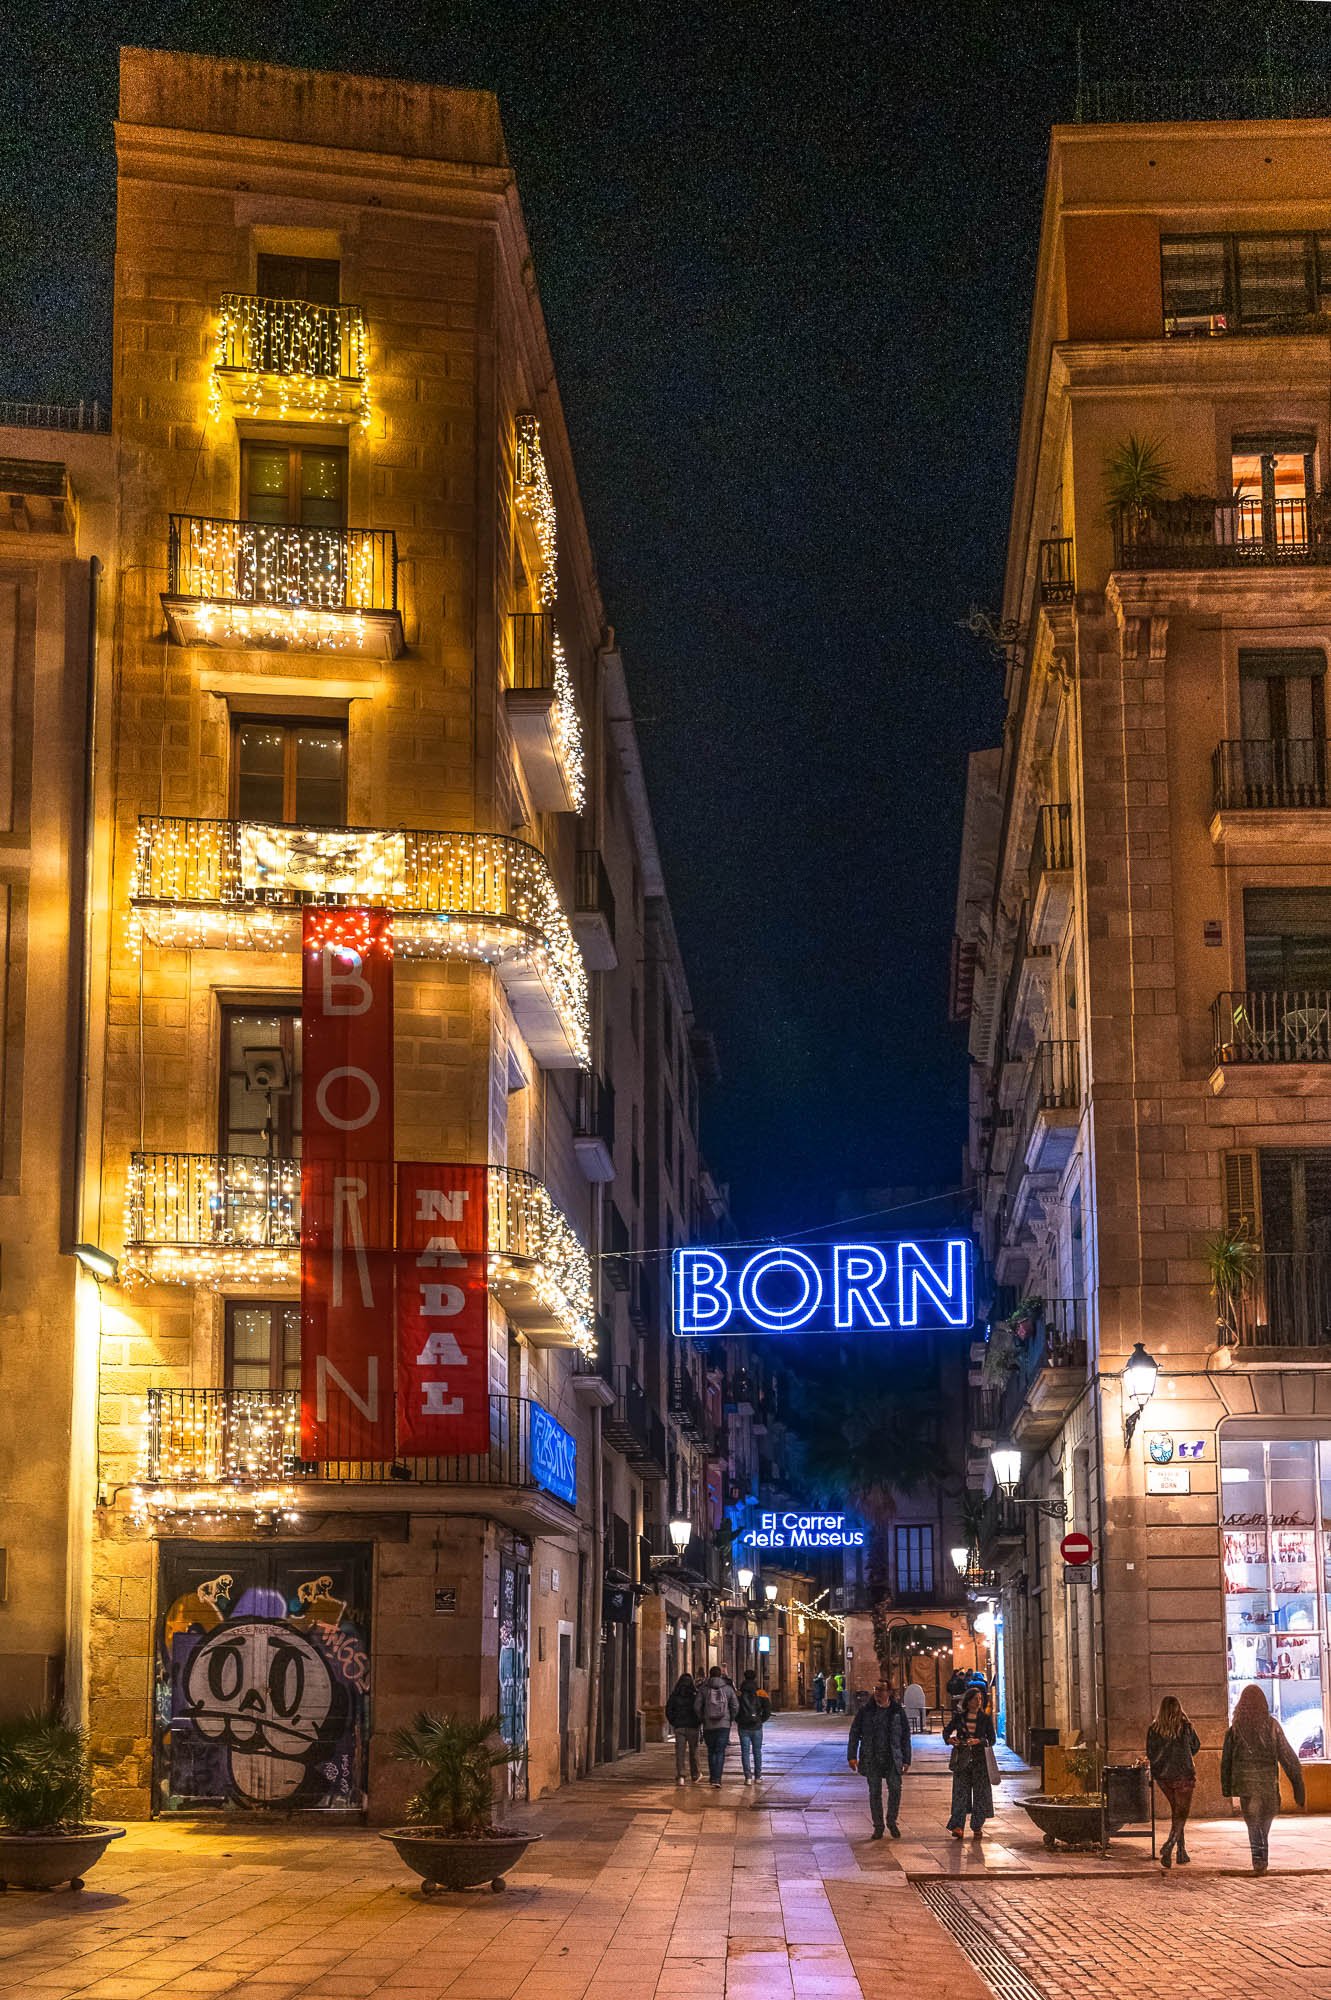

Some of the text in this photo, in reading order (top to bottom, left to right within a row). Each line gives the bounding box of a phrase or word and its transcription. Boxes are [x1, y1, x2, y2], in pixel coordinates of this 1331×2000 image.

[314, 946, 381, 1422] BORN
[415, 1189, 470, 1416] NADAL
[679, 1240, 968, 1332] BORN
[743, 1529, 864, 1547] dels Museus
[762, 1513, 845, 1530] El Carrer
